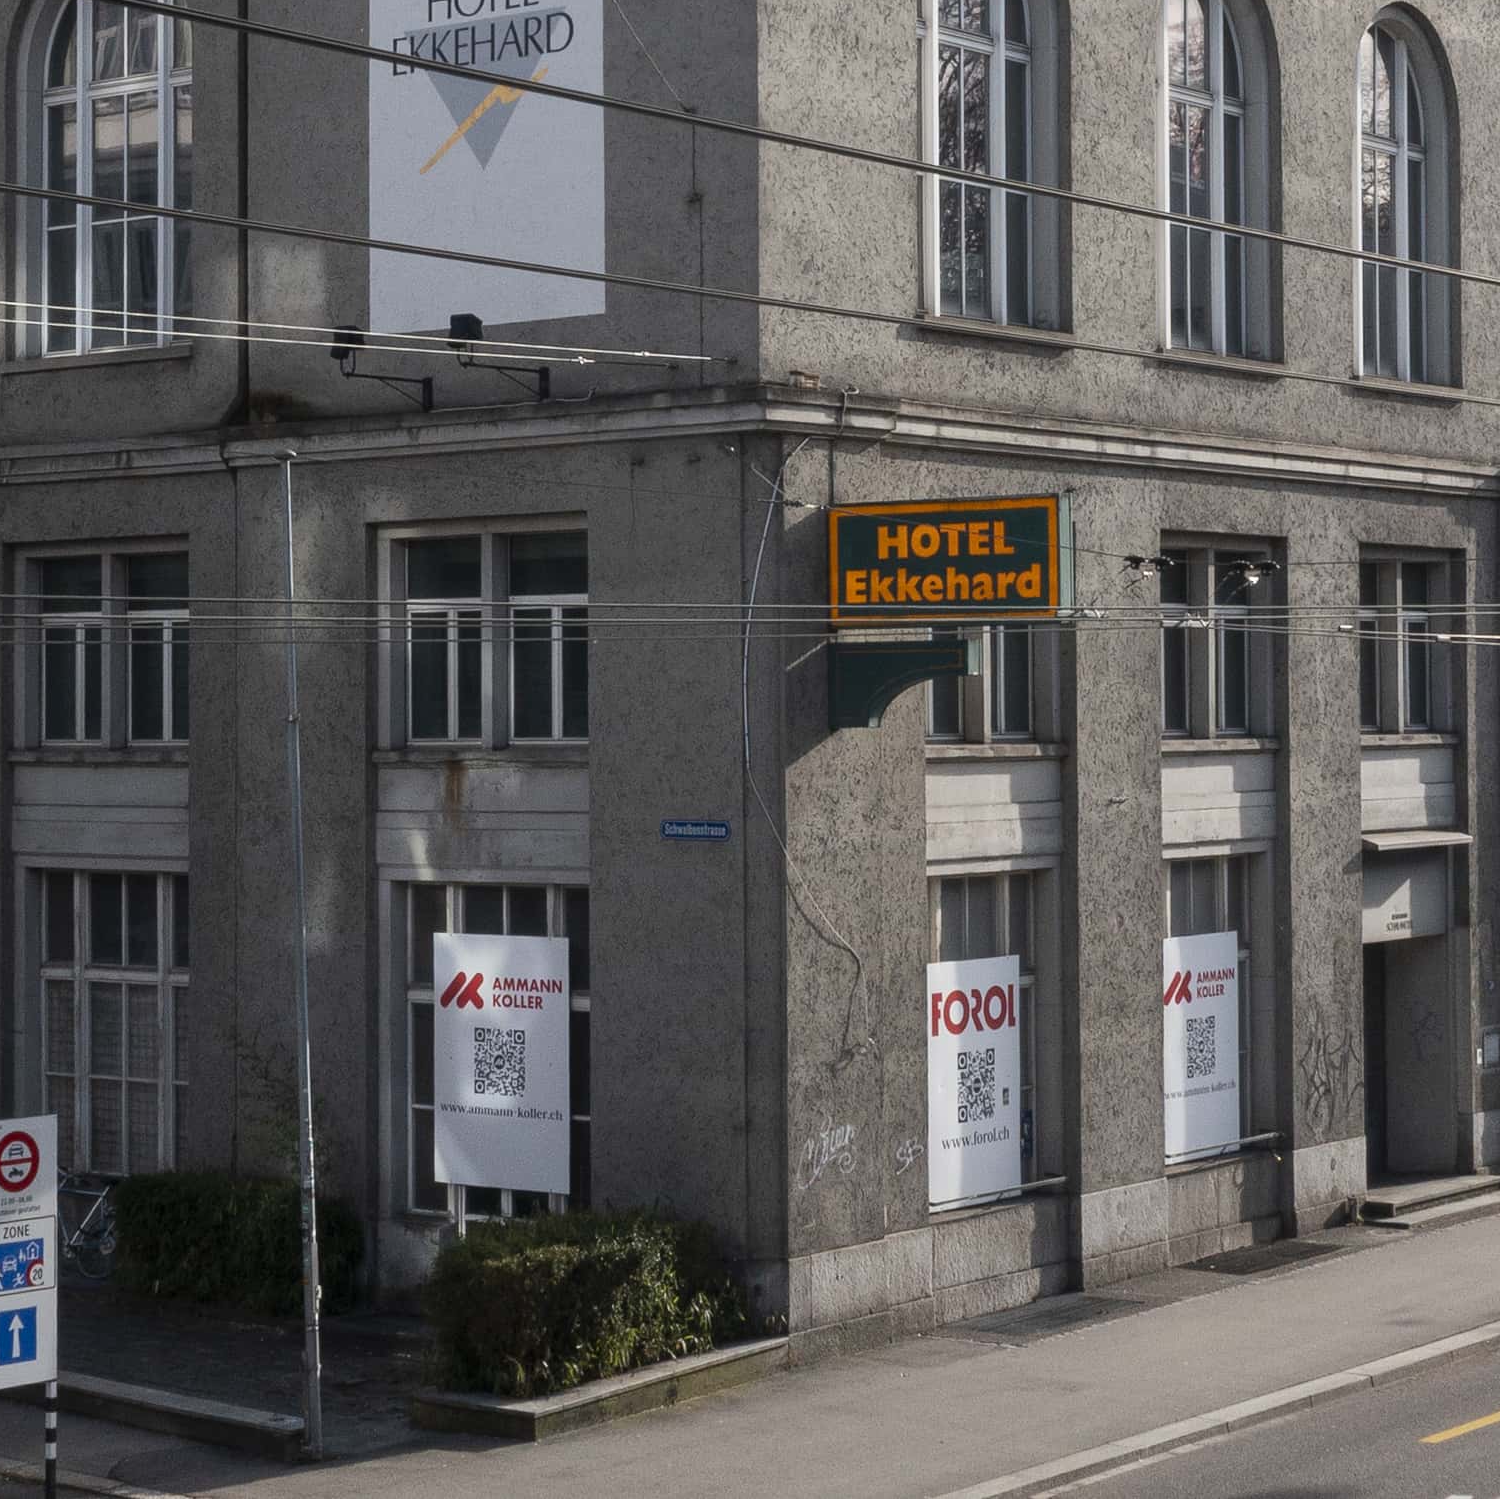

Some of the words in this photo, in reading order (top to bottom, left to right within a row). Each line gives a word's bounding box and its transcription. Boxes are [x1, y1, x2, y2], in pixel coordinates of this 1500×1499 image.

[392, 11, 575, 77] EKKEHARD
[877, 520, 1015, 560] HOTEL
[845, 562, 1042, 604] Ekkehard
[1196, 967, 1235, 983] AMMANN
[492, 977, 563, 994] AMMANN
[1196, 983, 1225, 999] KOLLER
[492, 994, 543, 1010] KOLLER
[931, 984, 1016, 1037] FOROL
[440, 1101, 564, 1122] www.ammann-koller.ch
[941, 1125, 1010, 1150] www.forol.ch
[3, 1224, 30, 1239] ZONE
[32, 1267, 43, 1281] 20
